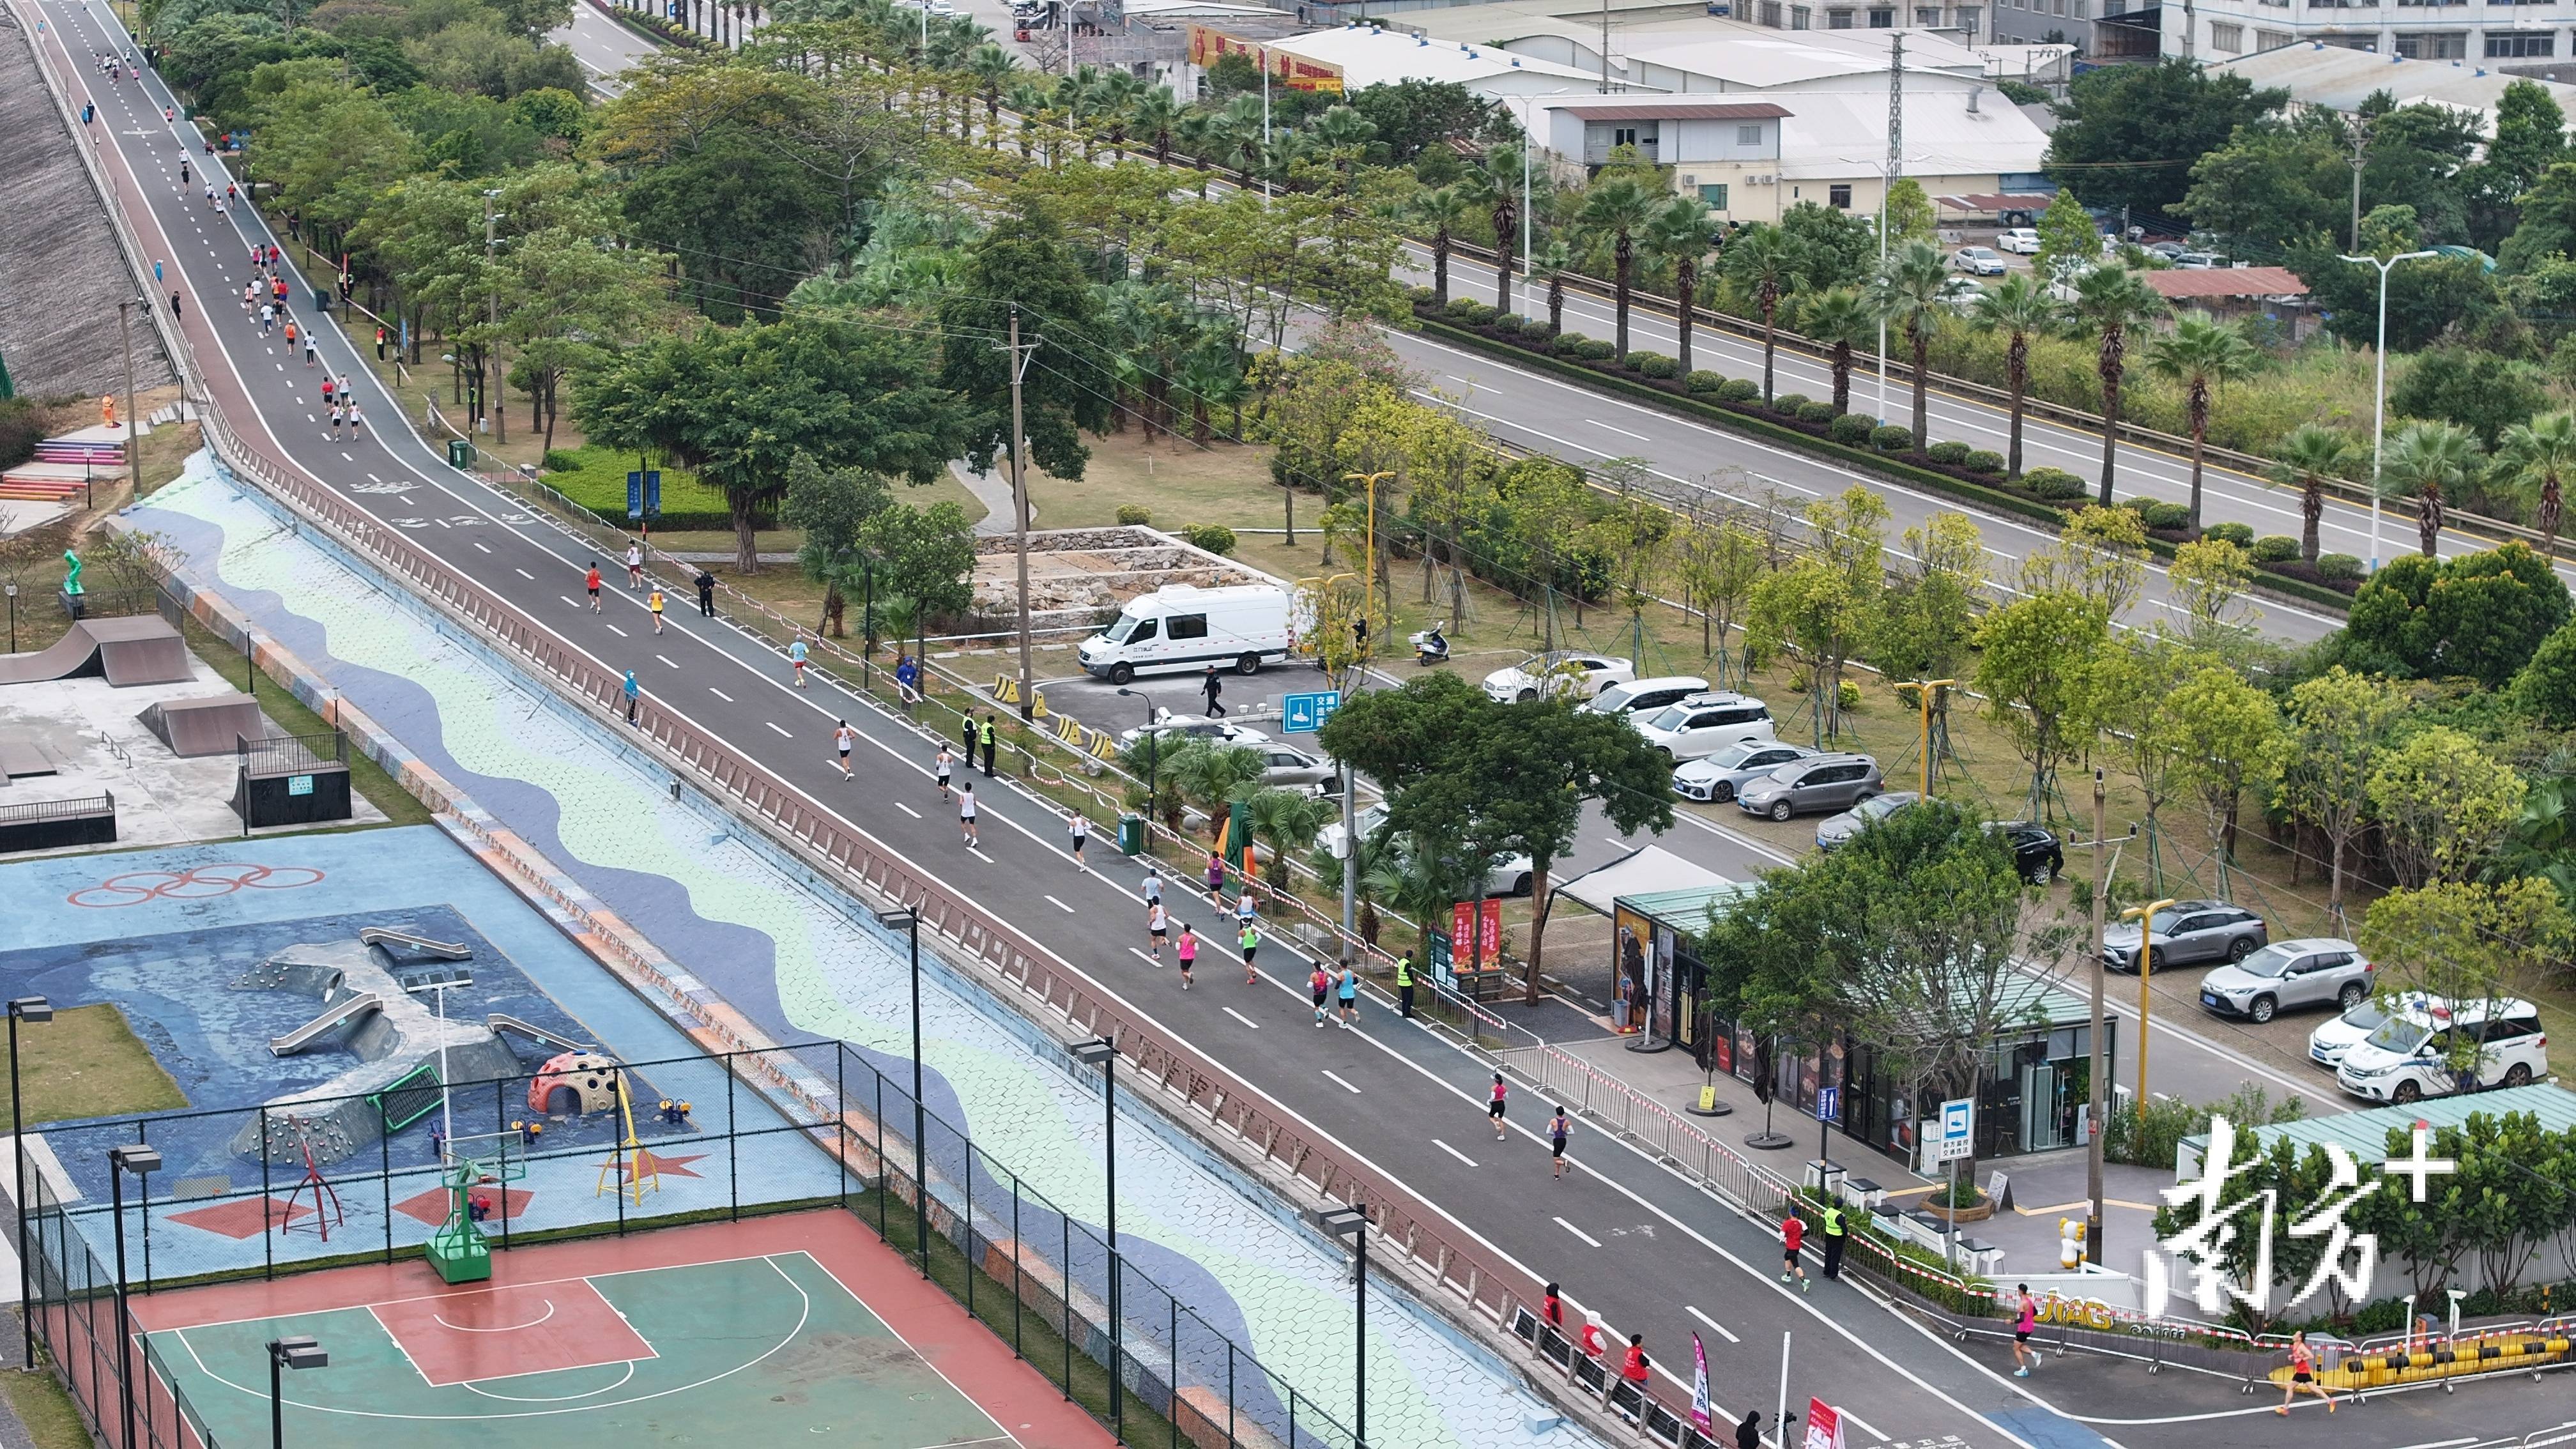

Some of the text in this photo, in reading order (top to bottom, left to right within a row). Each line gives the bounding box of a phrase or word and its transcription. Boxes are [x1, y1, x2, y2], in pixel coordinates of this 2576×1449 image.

[1316, 695, 1335, 706] 交通
[1943, 1139, 1969, 1149] 前方监控
[1943, 1147, 1968, 1156] 交通违法
